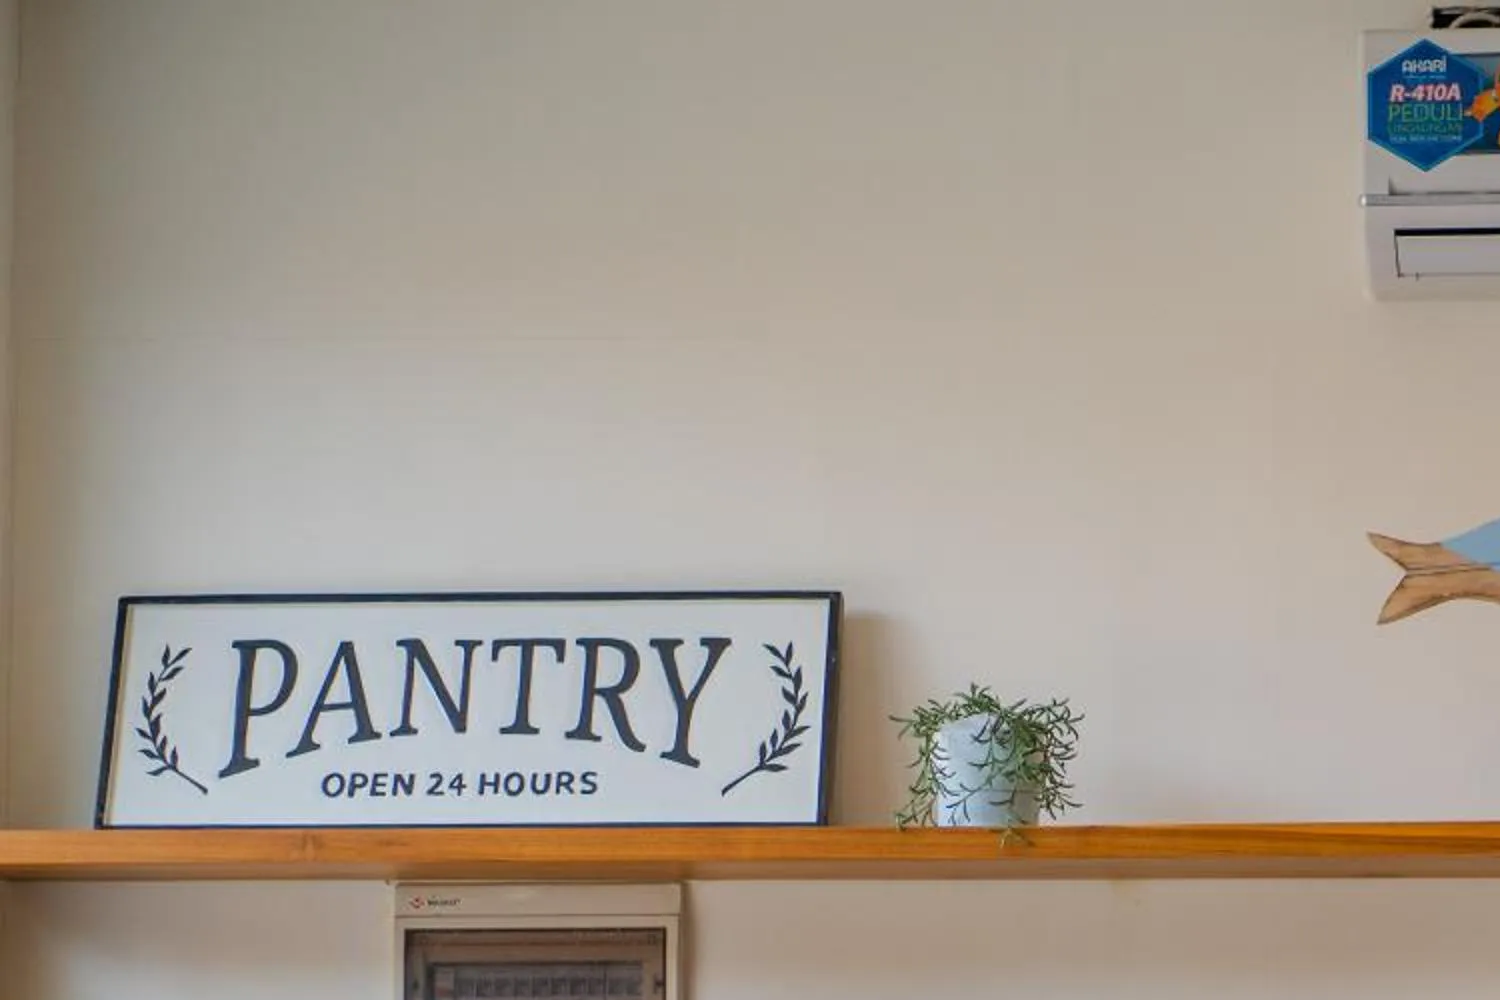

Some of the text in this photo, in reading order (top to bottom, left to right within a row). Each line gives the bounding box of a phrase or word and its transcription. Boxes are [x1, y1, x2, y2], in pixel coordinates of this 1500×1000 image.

[1390, 82, 1461, 102] R-410A
[1389, 103, 1463, 122] PEDULI
[217, 637, 732, 778] PANTRY
[321, 771, 599, 798] OPEN 24 HOURS
